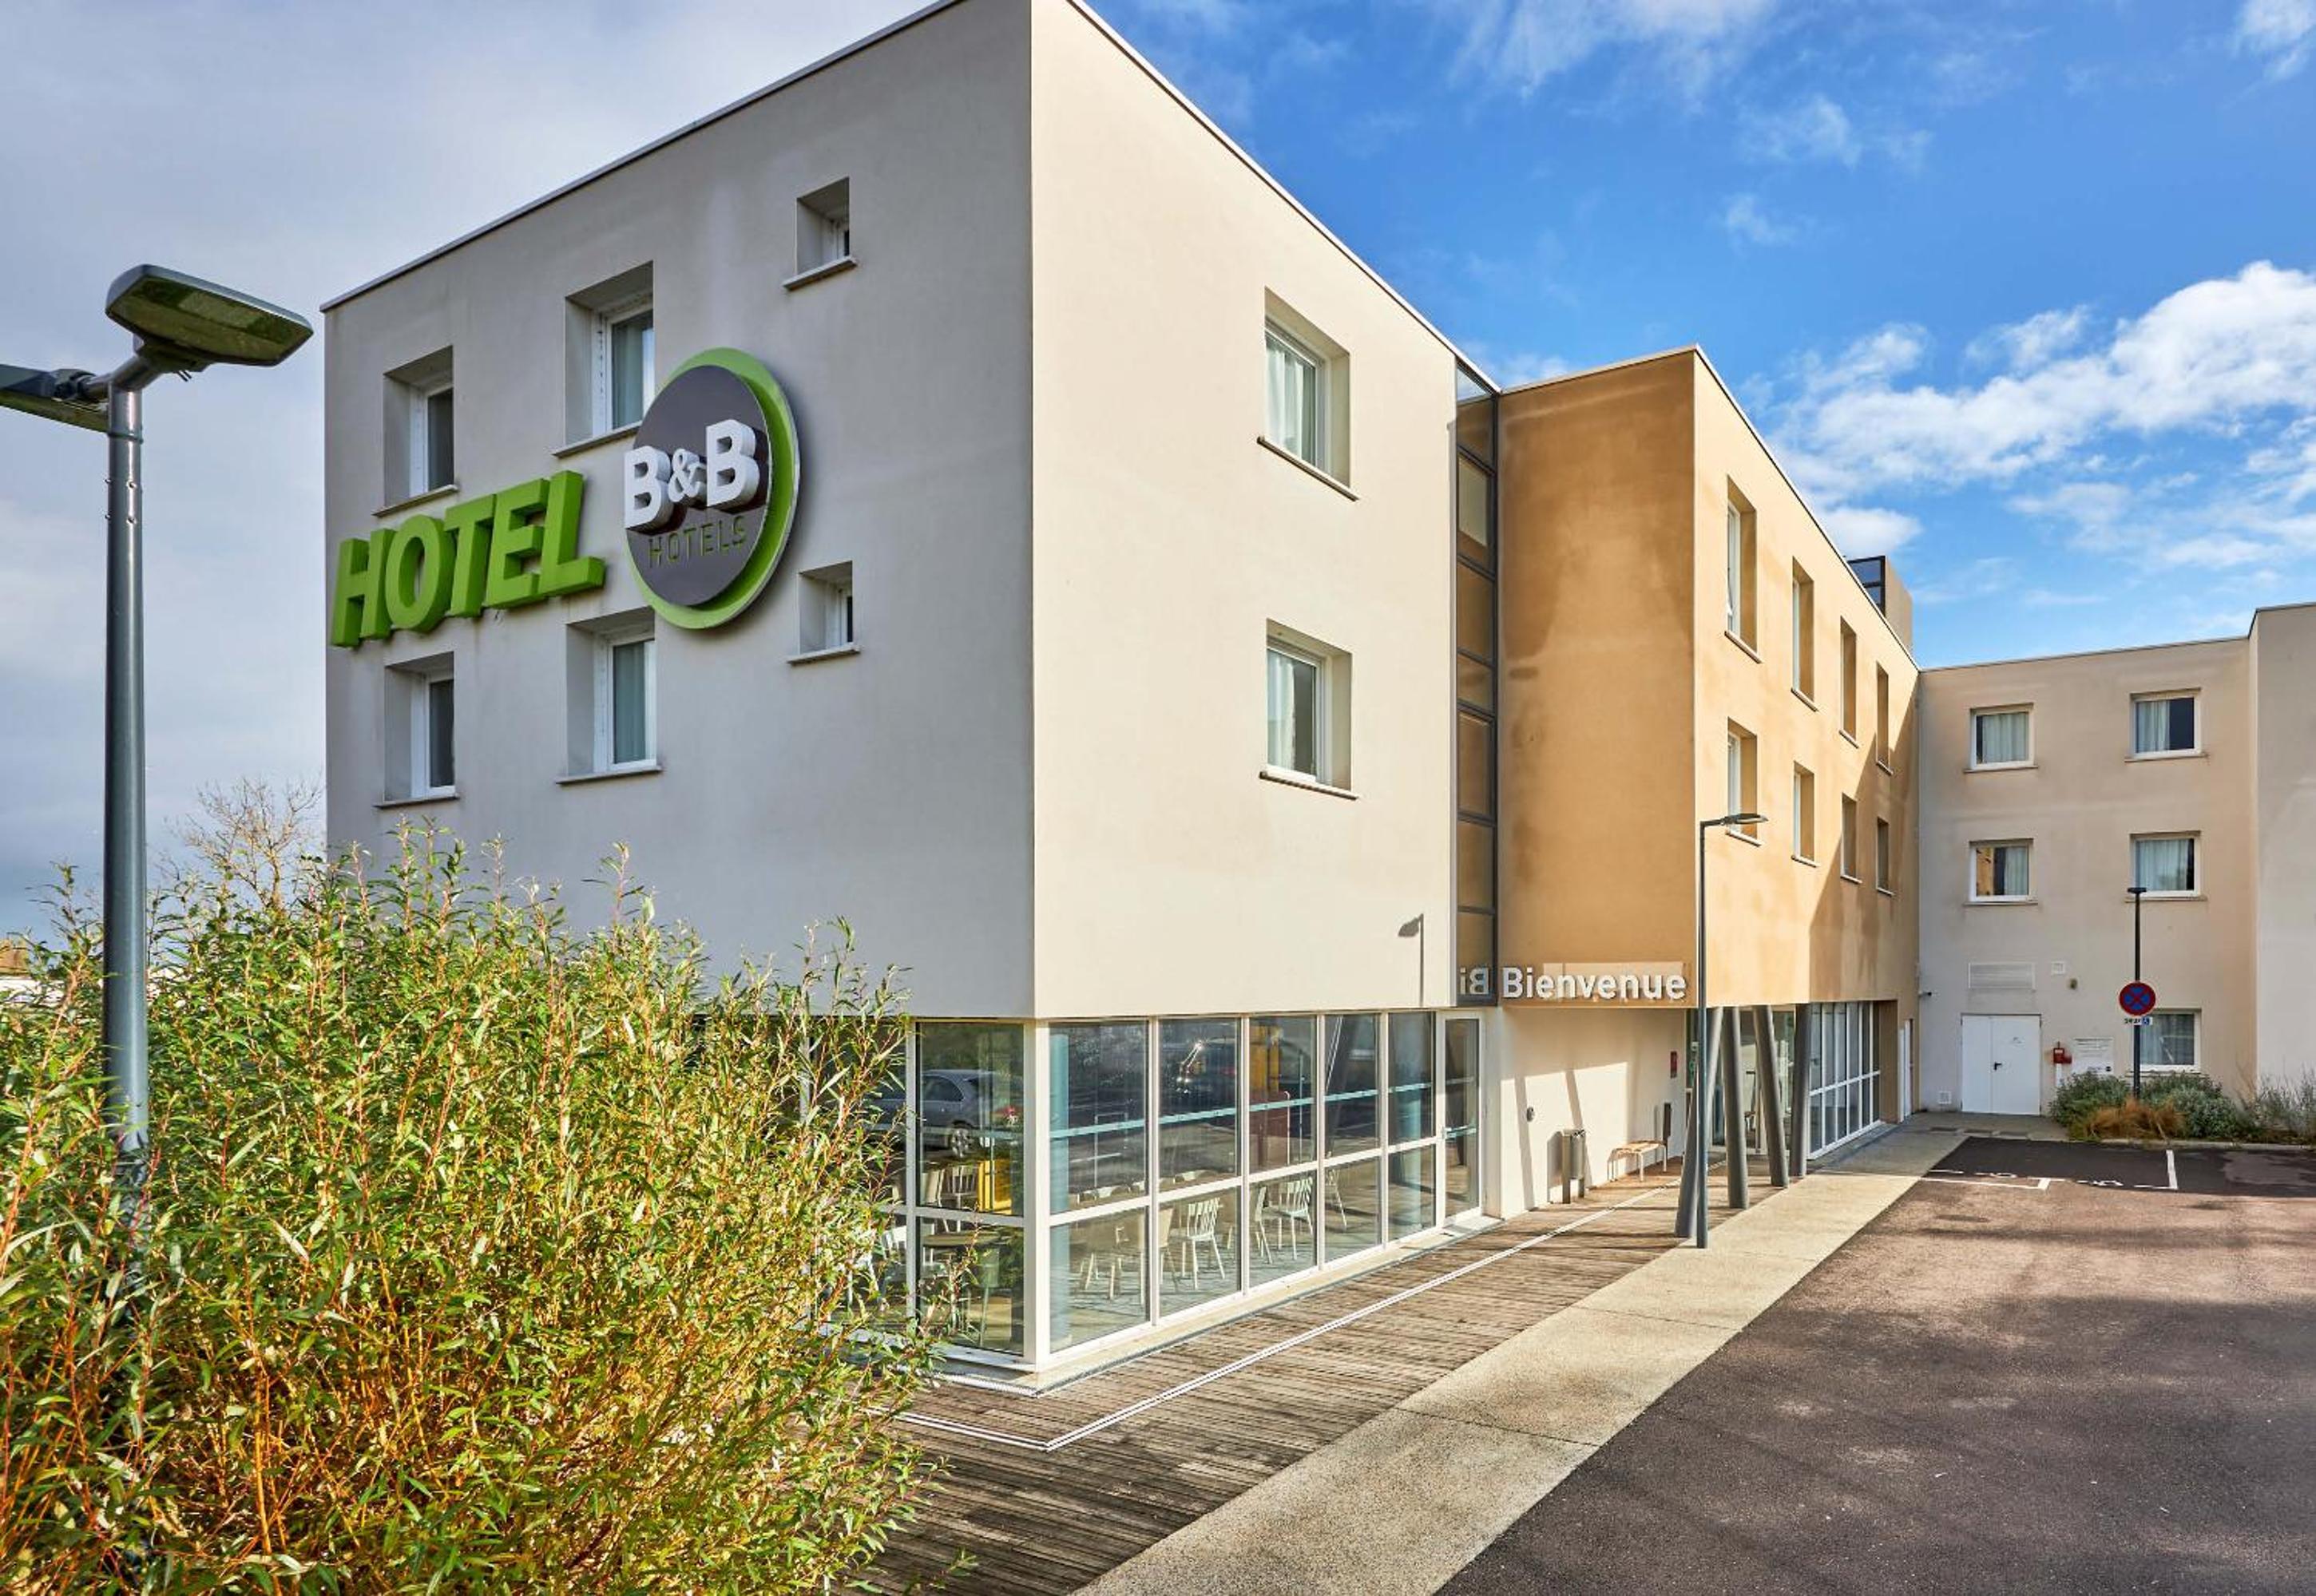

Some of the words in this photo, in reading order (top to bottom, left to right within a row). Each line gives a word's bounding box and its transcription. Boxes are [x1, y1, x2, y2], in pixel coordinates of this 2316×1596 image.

[625, 419, 760, 529] B&B
[331, 470, 605, 648] HOTEL
[648, 516, 747, 568] HOTELS
[1502, 967, 1687, 1000] Bienvenue
